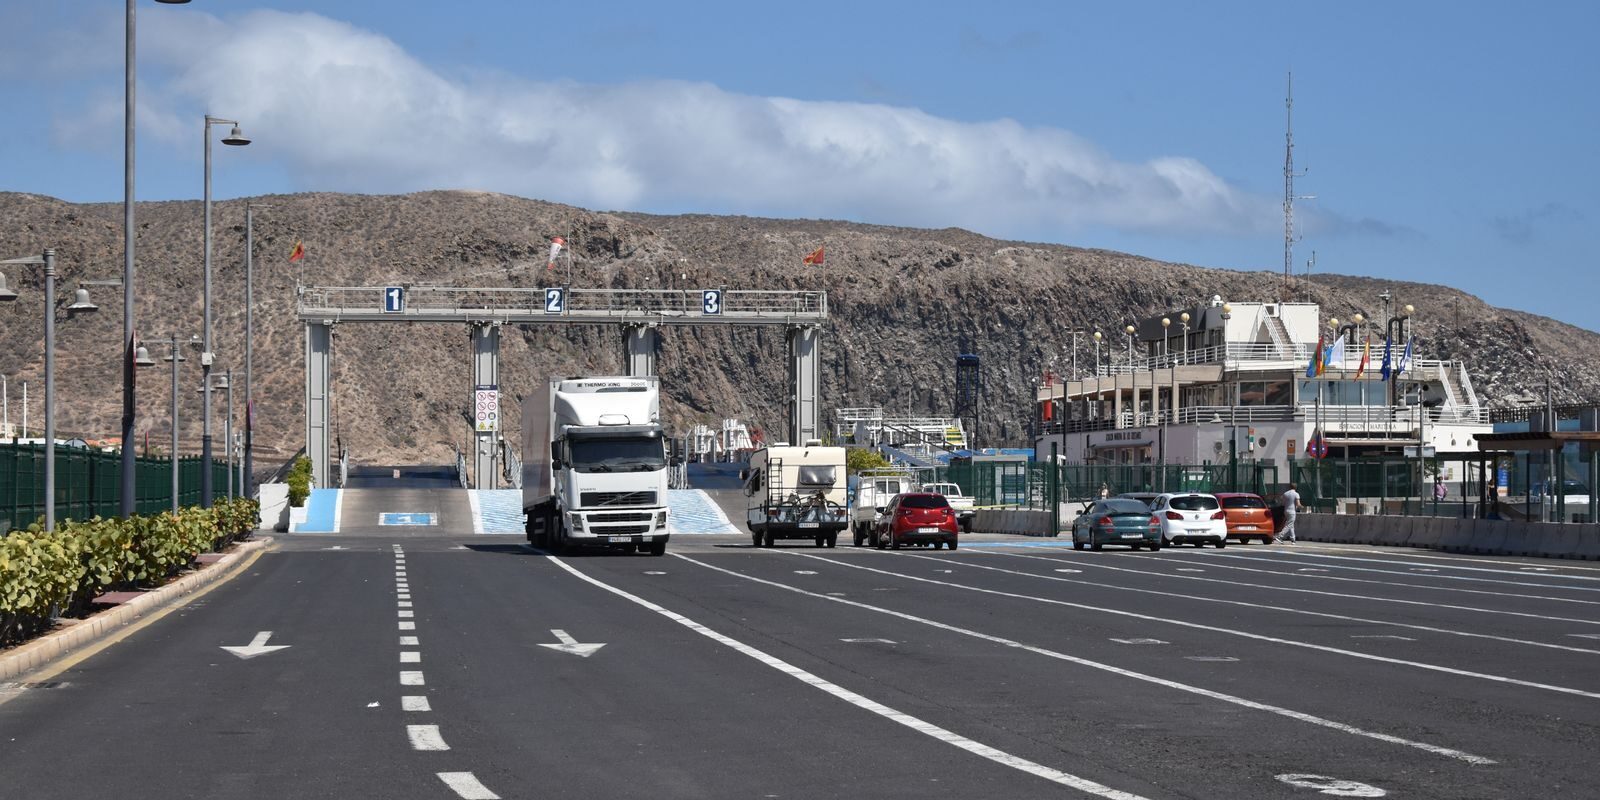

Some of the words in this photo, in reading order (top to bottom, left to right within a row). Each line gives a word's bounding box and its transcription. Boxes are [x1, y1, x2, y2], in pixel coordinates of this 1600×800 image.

[389, 289, 399, 310] 1
[547, 290, 561, 311] 2
[705, 291, 718, 313] 3
